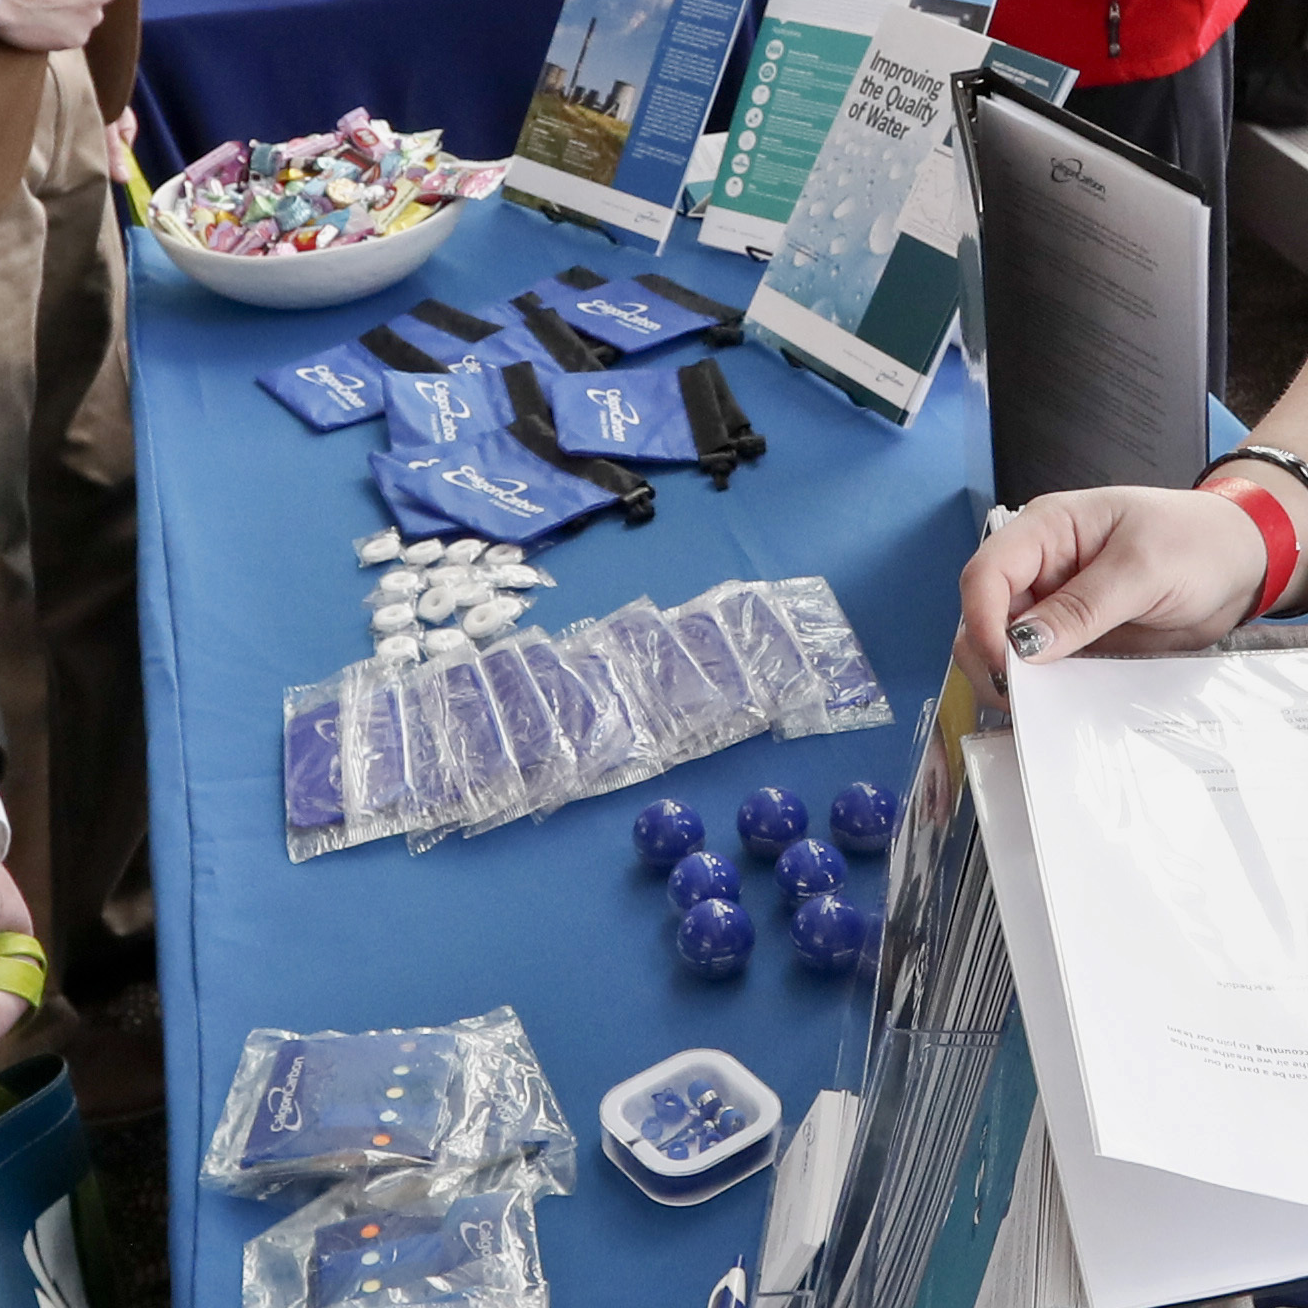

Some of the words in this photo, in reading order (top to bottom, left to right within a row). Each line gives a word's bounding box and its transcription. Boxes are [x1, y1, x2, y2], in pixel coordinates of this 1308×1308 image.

[869, 49, 945, 101] Improving
[859, 75, 884, 100] the
[885, 85, 939, 128] Quality
[848, 101, 868, 121] of
[865, 104, 911, 140] Water
[1165, 1025, 1194, 1040] team
[1203, 1057, 1222, 1066] our
[1211, 1049, 1254, 1065] breathe
[1224, 1062, 1235, 1072] of
[1238, 1065, 1260, 1076] part
[1272, 1070, 1286, 1080] be
[1288, 1072, 1308, 1081] can
